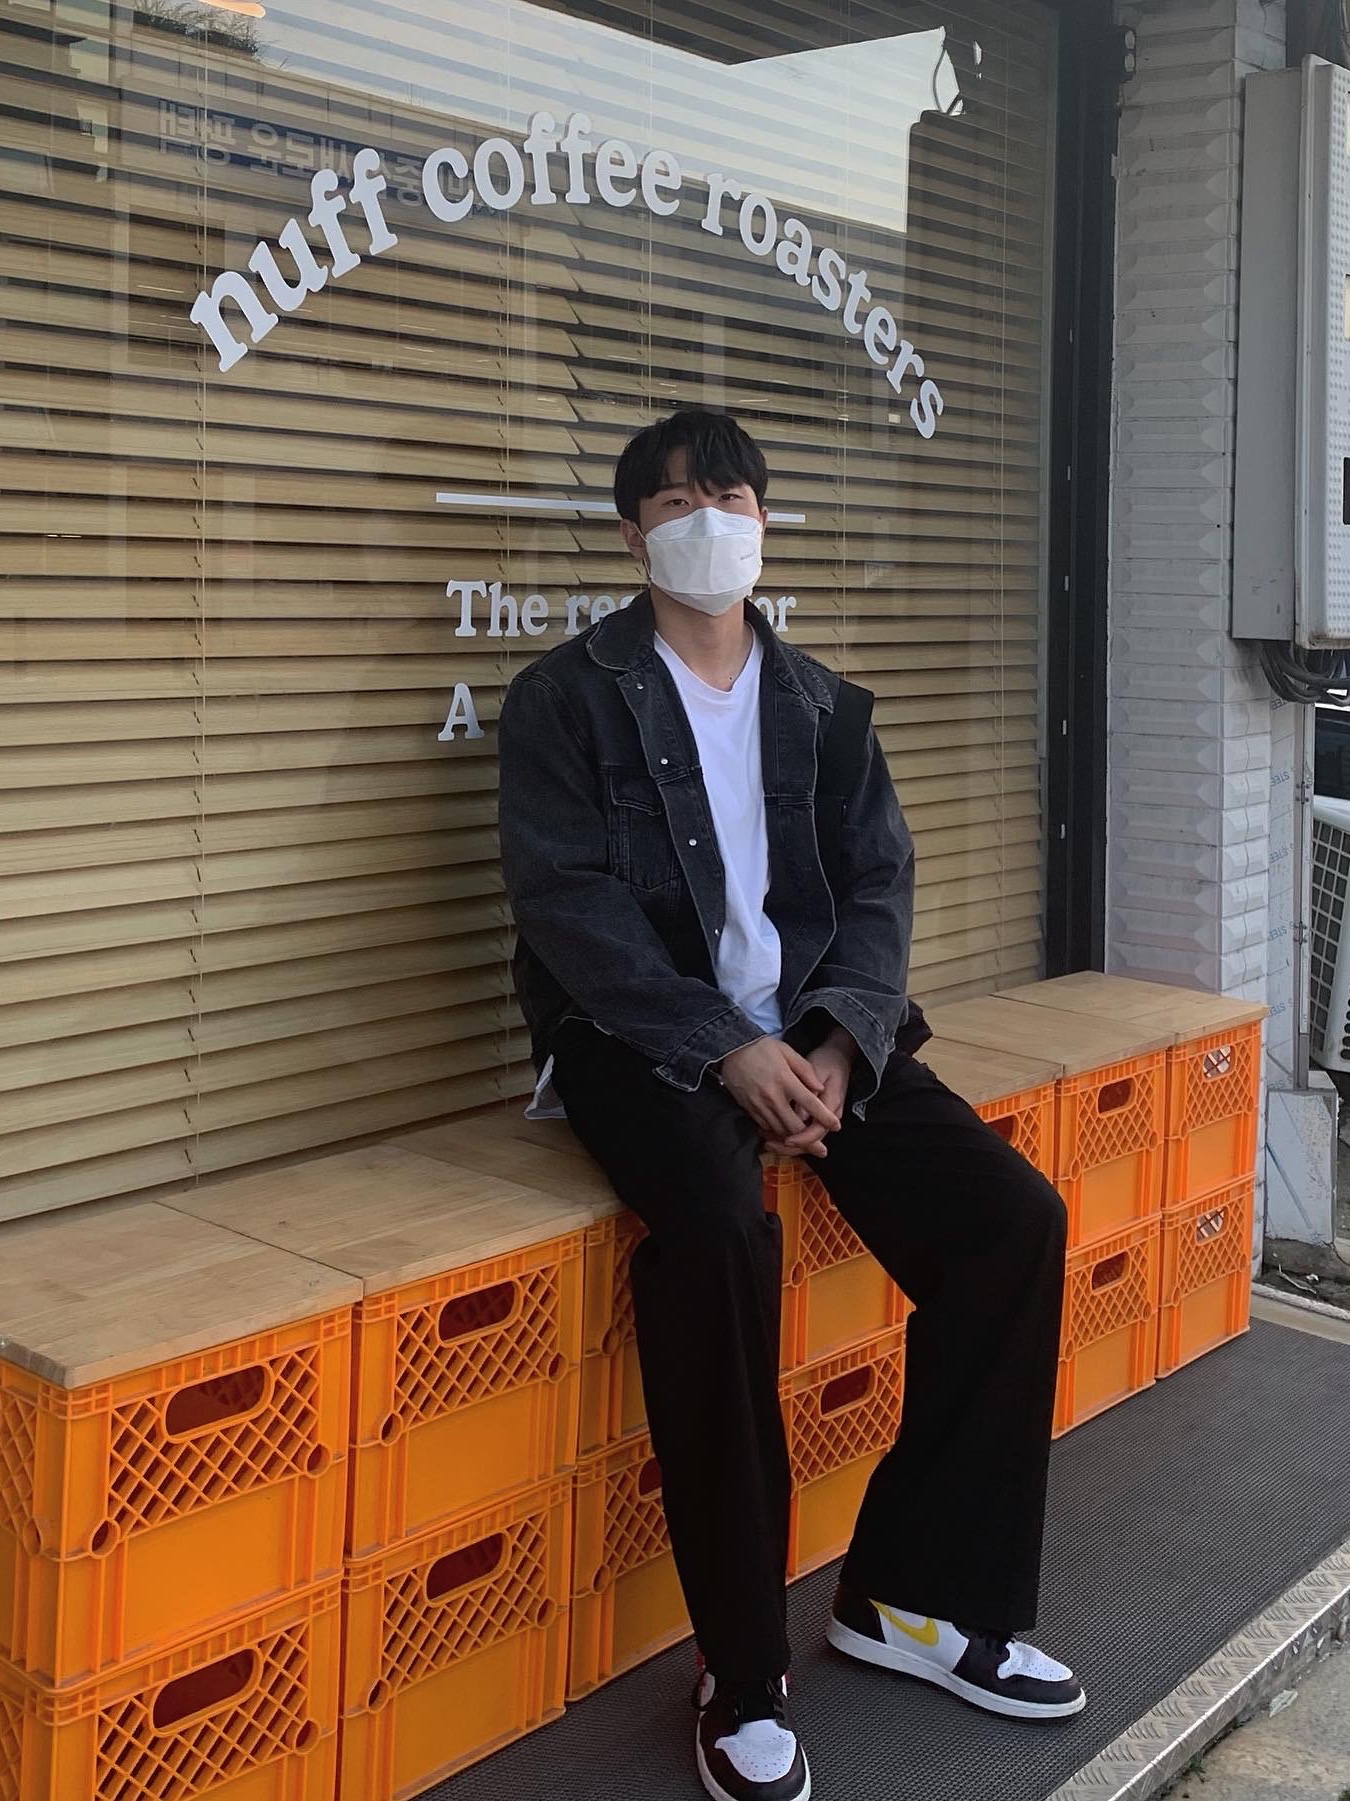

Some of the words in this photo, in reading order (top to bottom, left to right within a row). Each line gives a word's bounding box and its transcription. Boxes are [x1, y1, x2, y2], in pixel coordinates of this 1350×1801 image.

[189, 149, 398, 372] nuff
[422, 112, 683, 223] coffee
[702, 174, 944, 439] roasters
[446, 580, 549, 637] The
[755, 596, 797, 632] or
[438, 682, 485, 741] A
